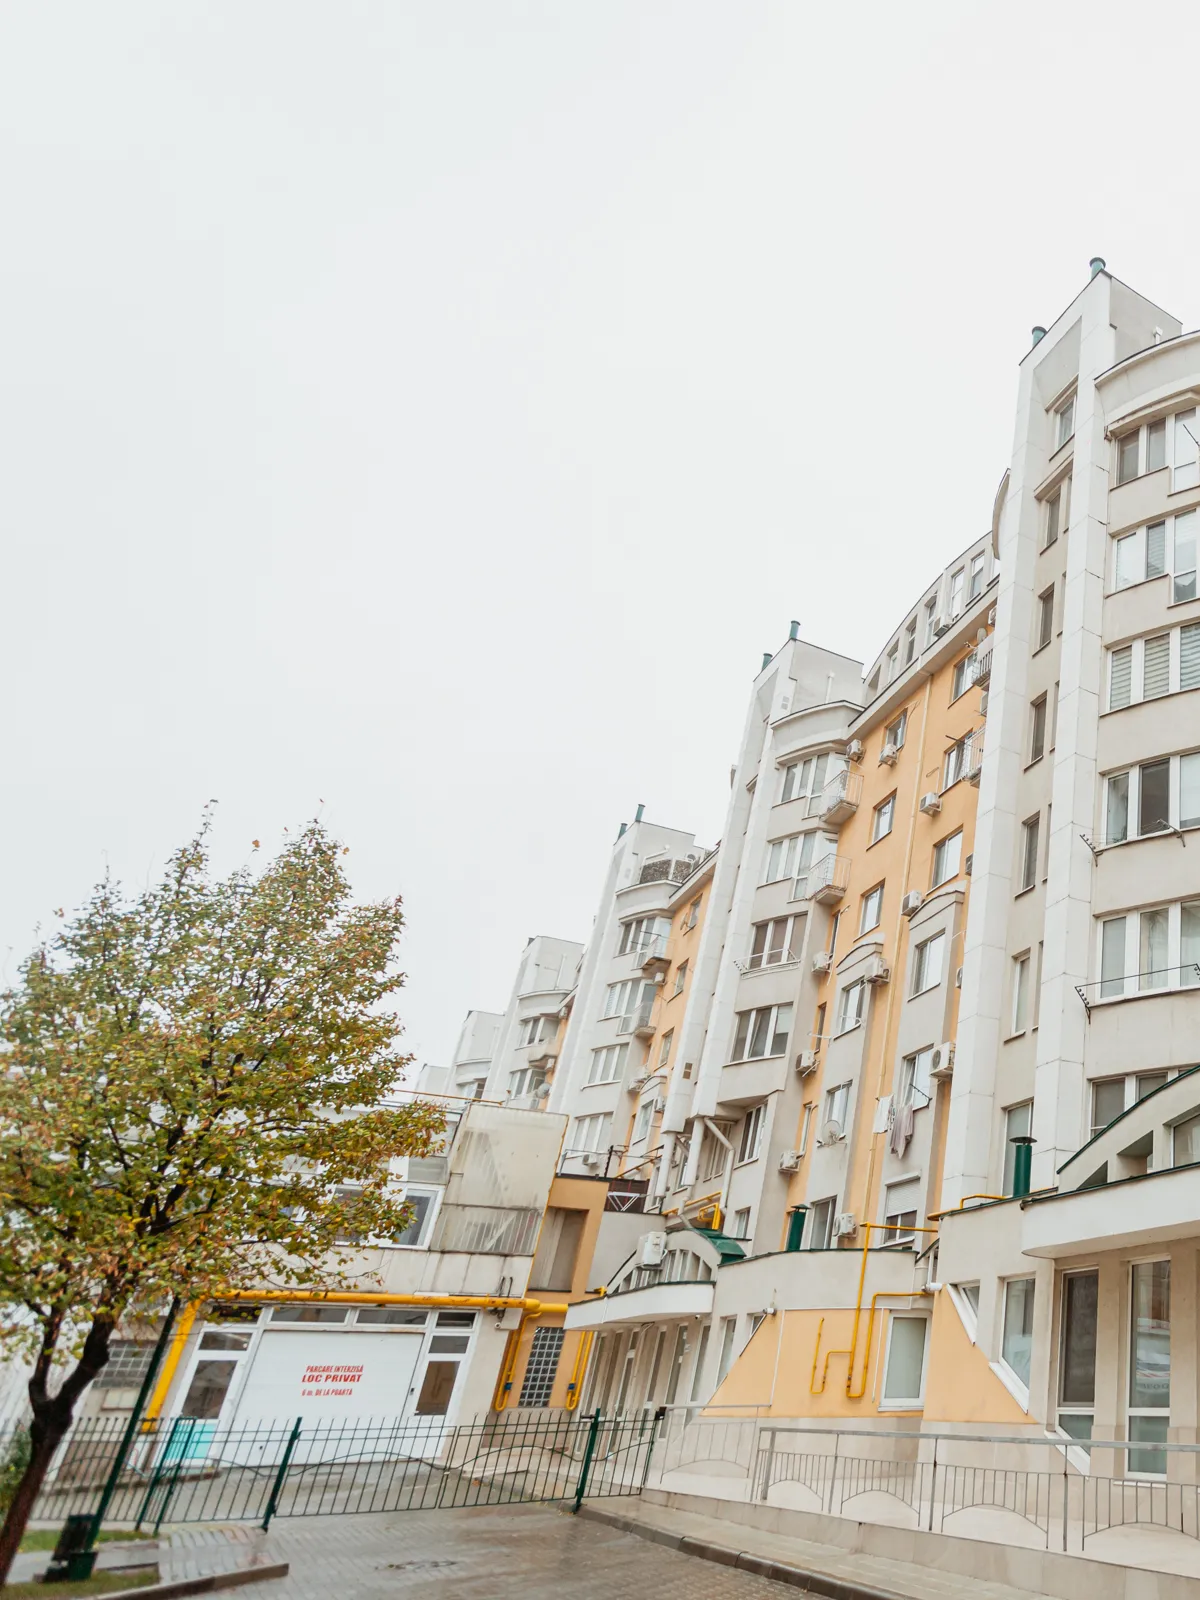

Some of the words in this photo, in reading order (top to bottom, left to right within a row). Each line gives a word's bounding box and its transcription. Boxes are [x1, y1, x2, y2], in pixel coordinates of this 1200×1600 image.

[305, 1365, 333, 1373] PARCARE
[301, 1374, 322, 1383] LOC
[324, 1374, 363, 1383] PRIVAT
